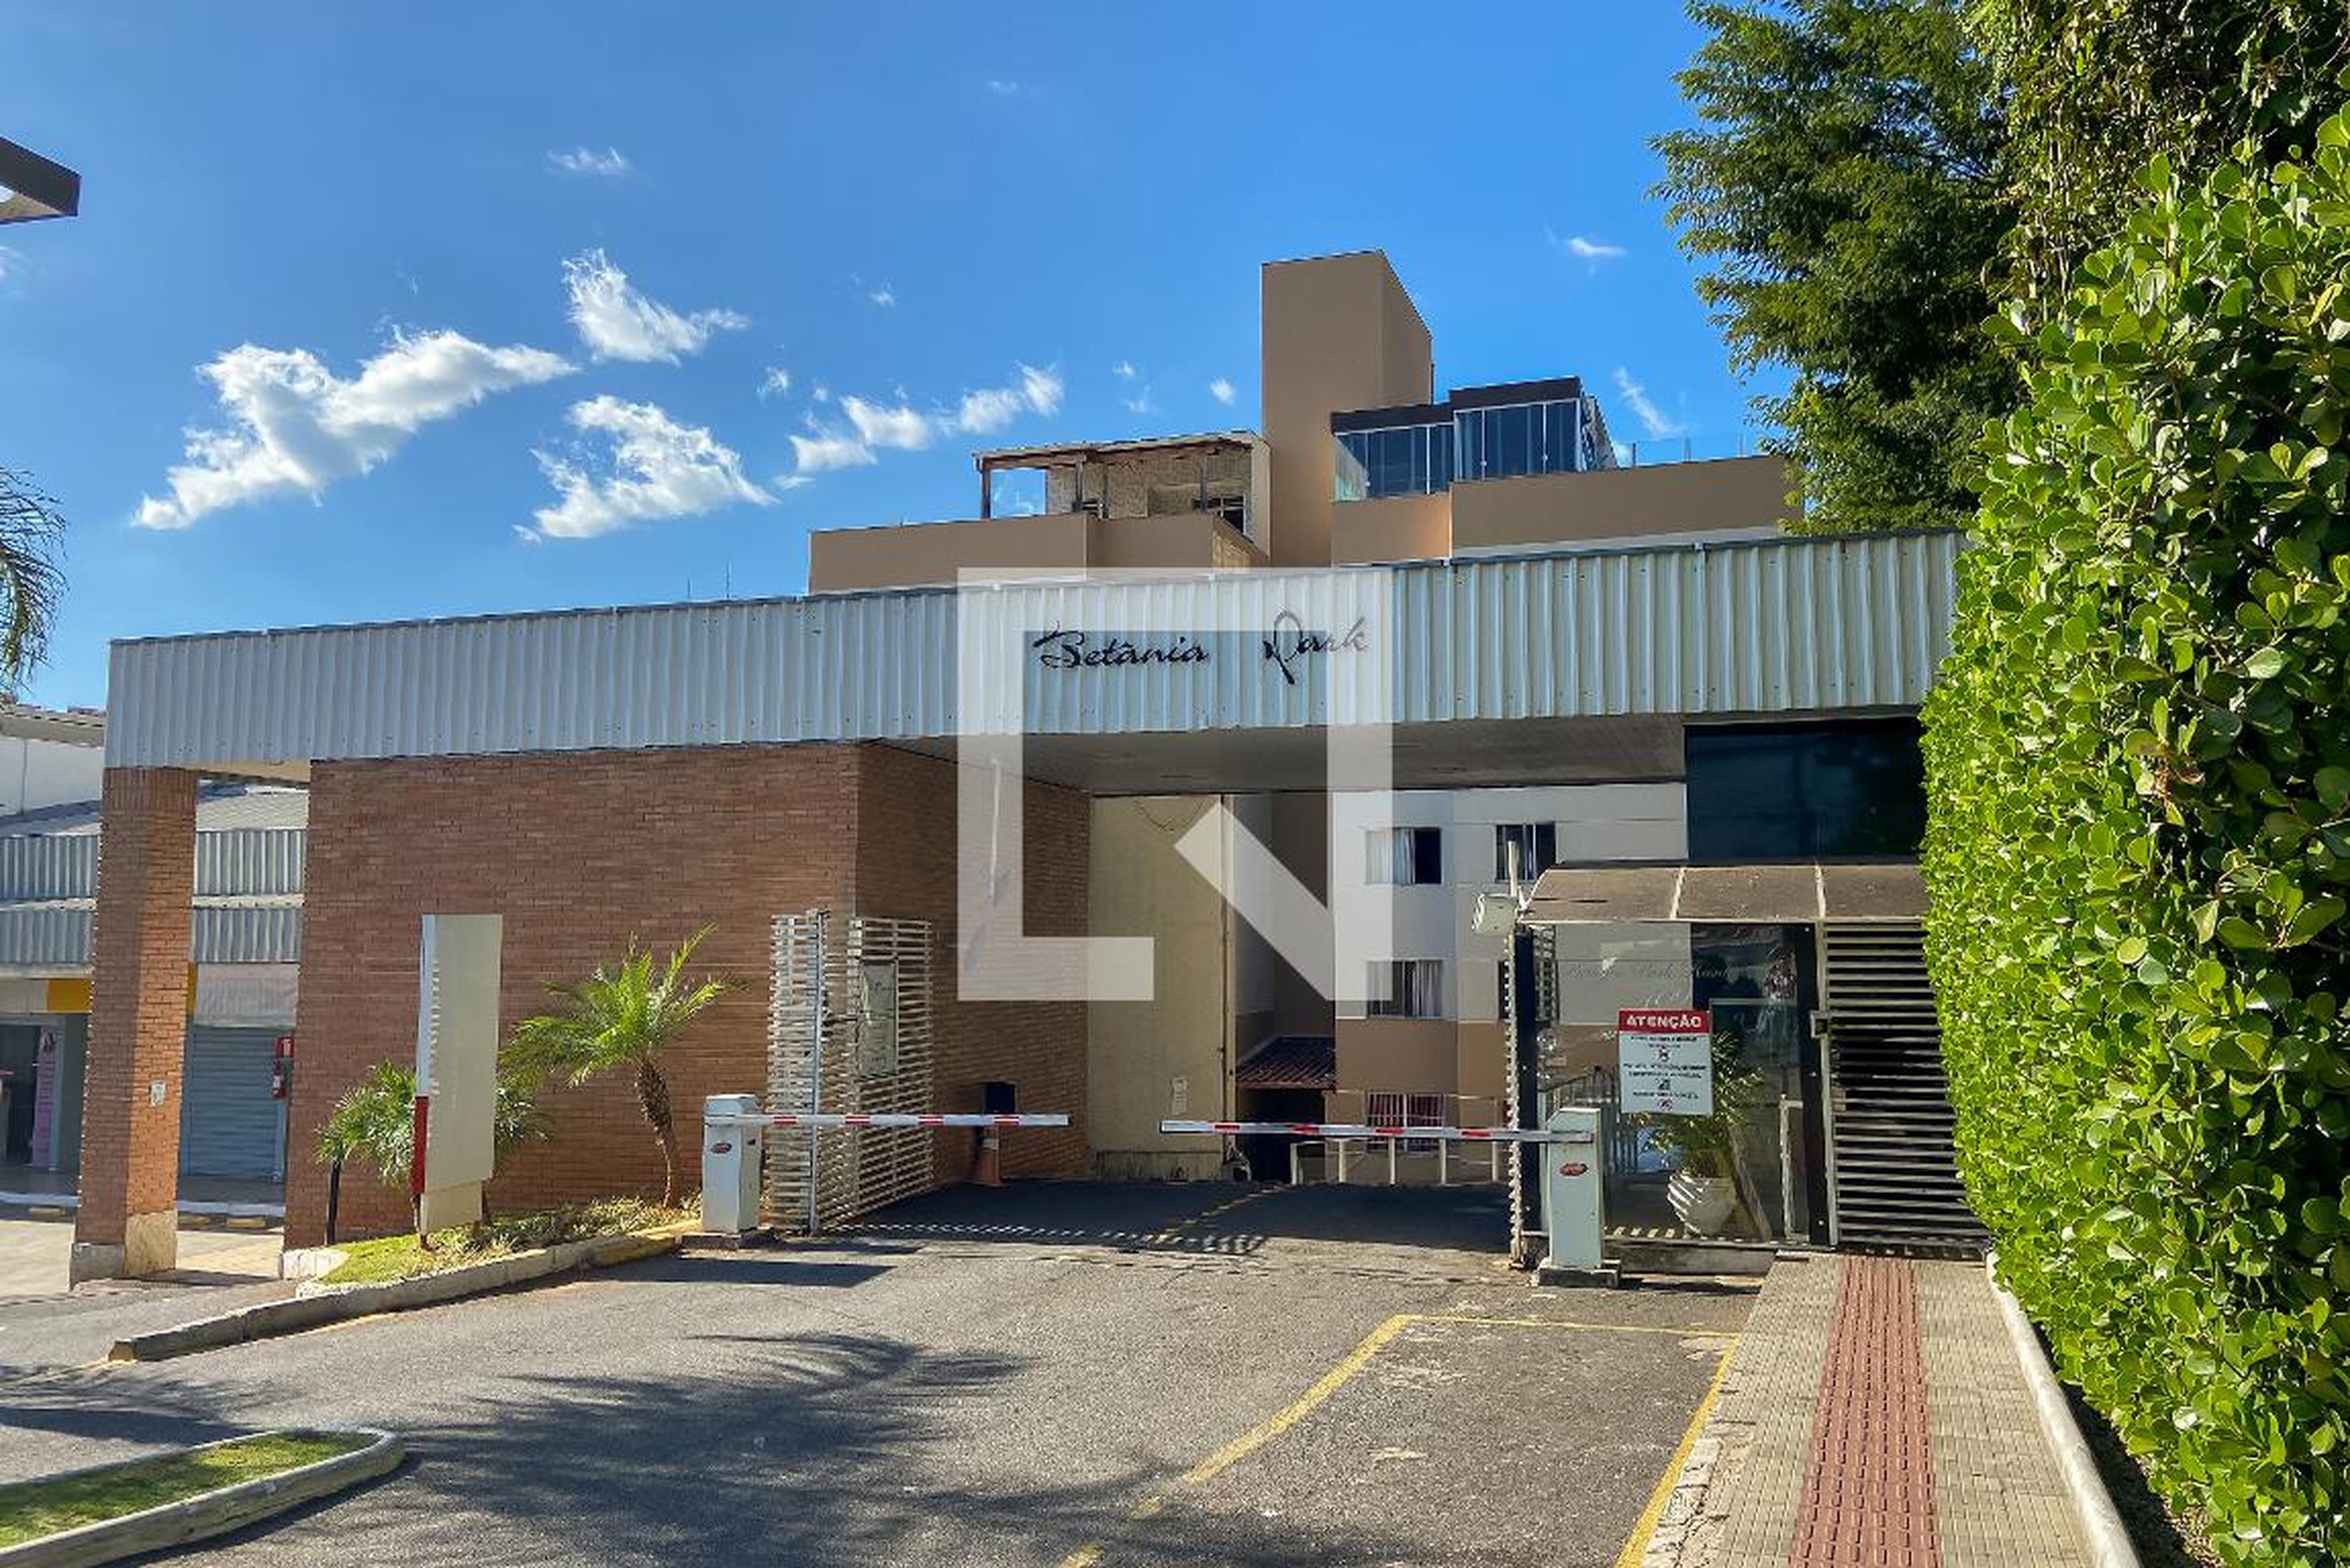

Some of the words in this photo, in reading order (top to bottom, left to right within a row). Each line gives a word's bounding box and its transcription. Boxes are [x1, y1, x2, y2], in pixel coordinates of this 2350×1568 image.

[1032, 620, 1209, 668] Betânia
[1262, 611, 1369, 685] Park
[1627, 1014, 1701, 1029] ATENÇÃO
